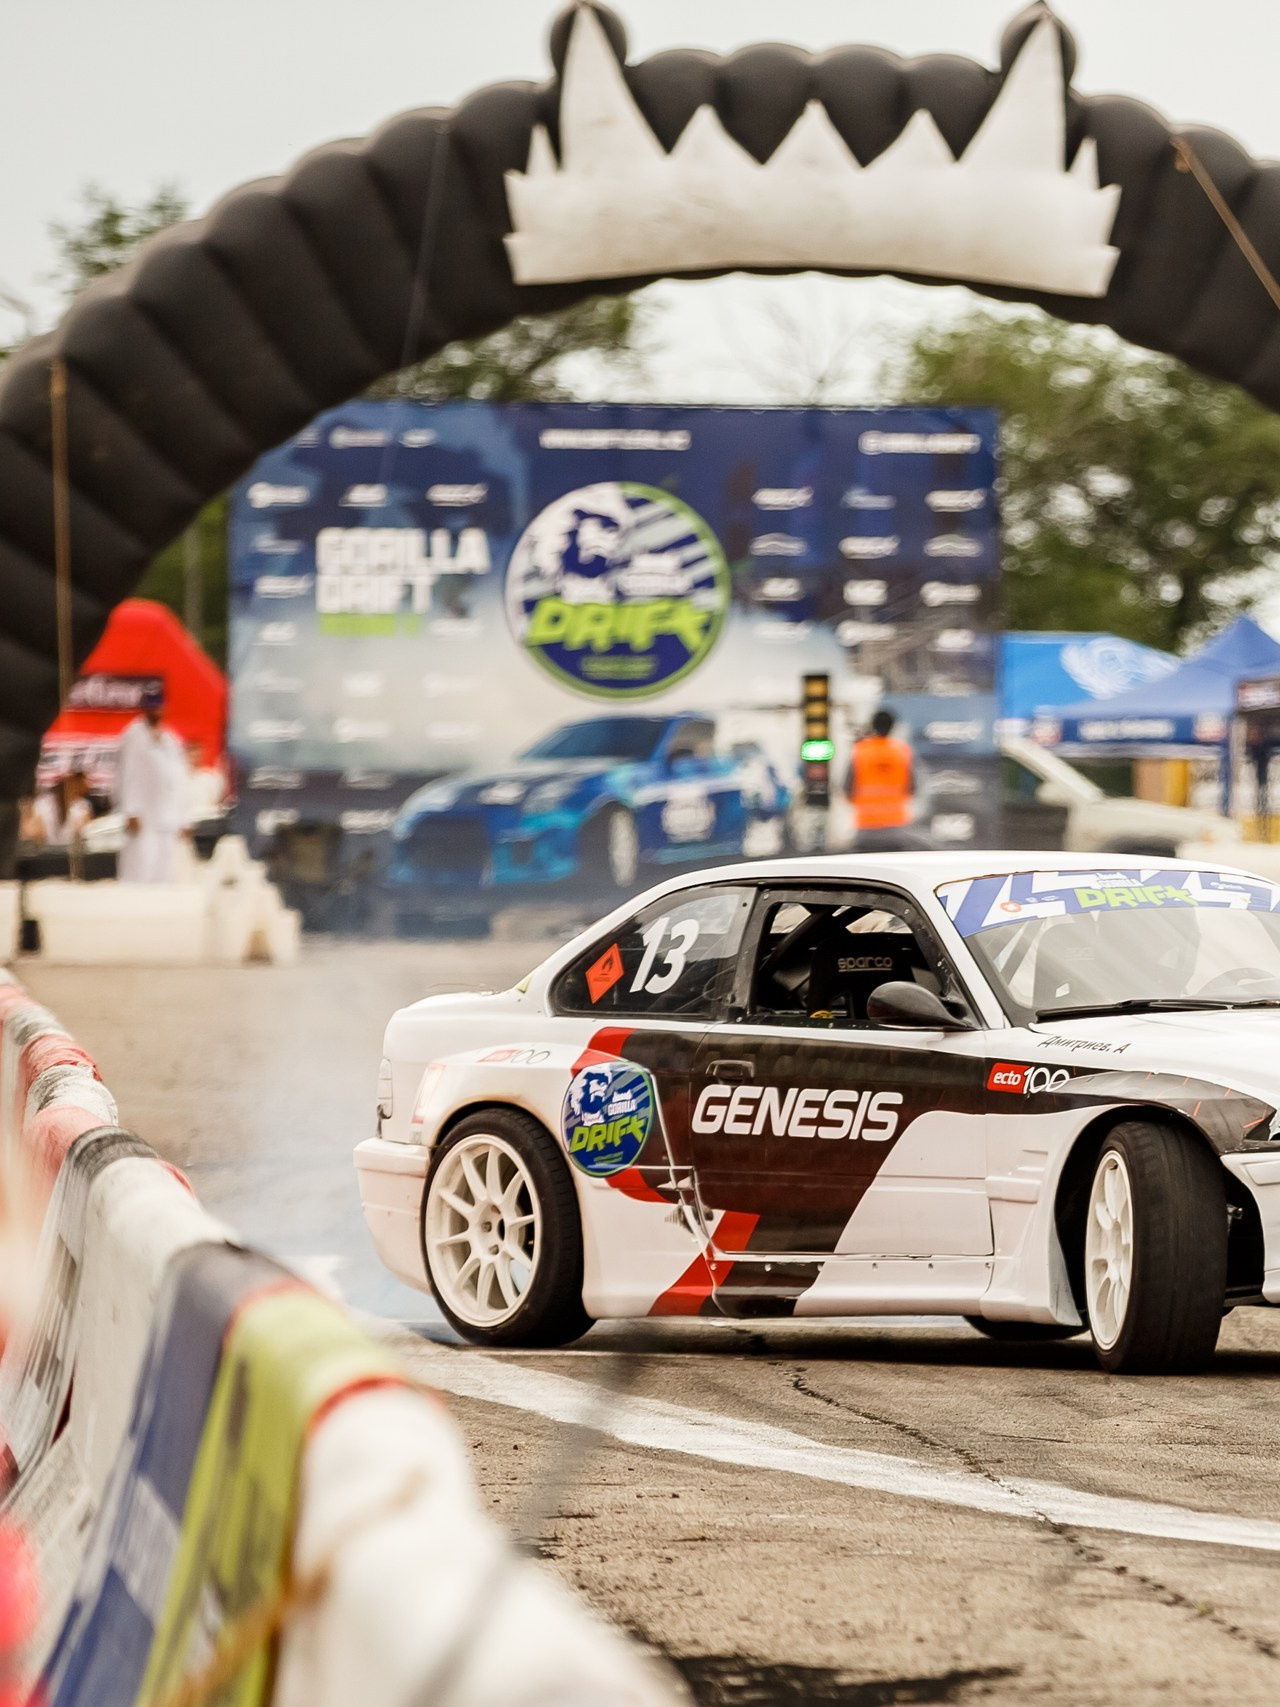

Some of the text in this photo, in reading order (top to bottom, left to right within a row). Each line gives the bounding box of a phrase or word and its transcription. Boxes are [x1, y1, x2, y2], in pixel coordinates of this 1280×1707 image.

[315, 527, 491, 574] GORILLA
[316, 574, 432, 613] DRIFT
[1074, 885, 1199, 909] DRIFT
[629, 916, 700, 994] 13
[837, 955, 894, 970] sparco
[692, 1084, 903, 1141] GENESIS
[569, 1115, 646, 1154] DRIFT
